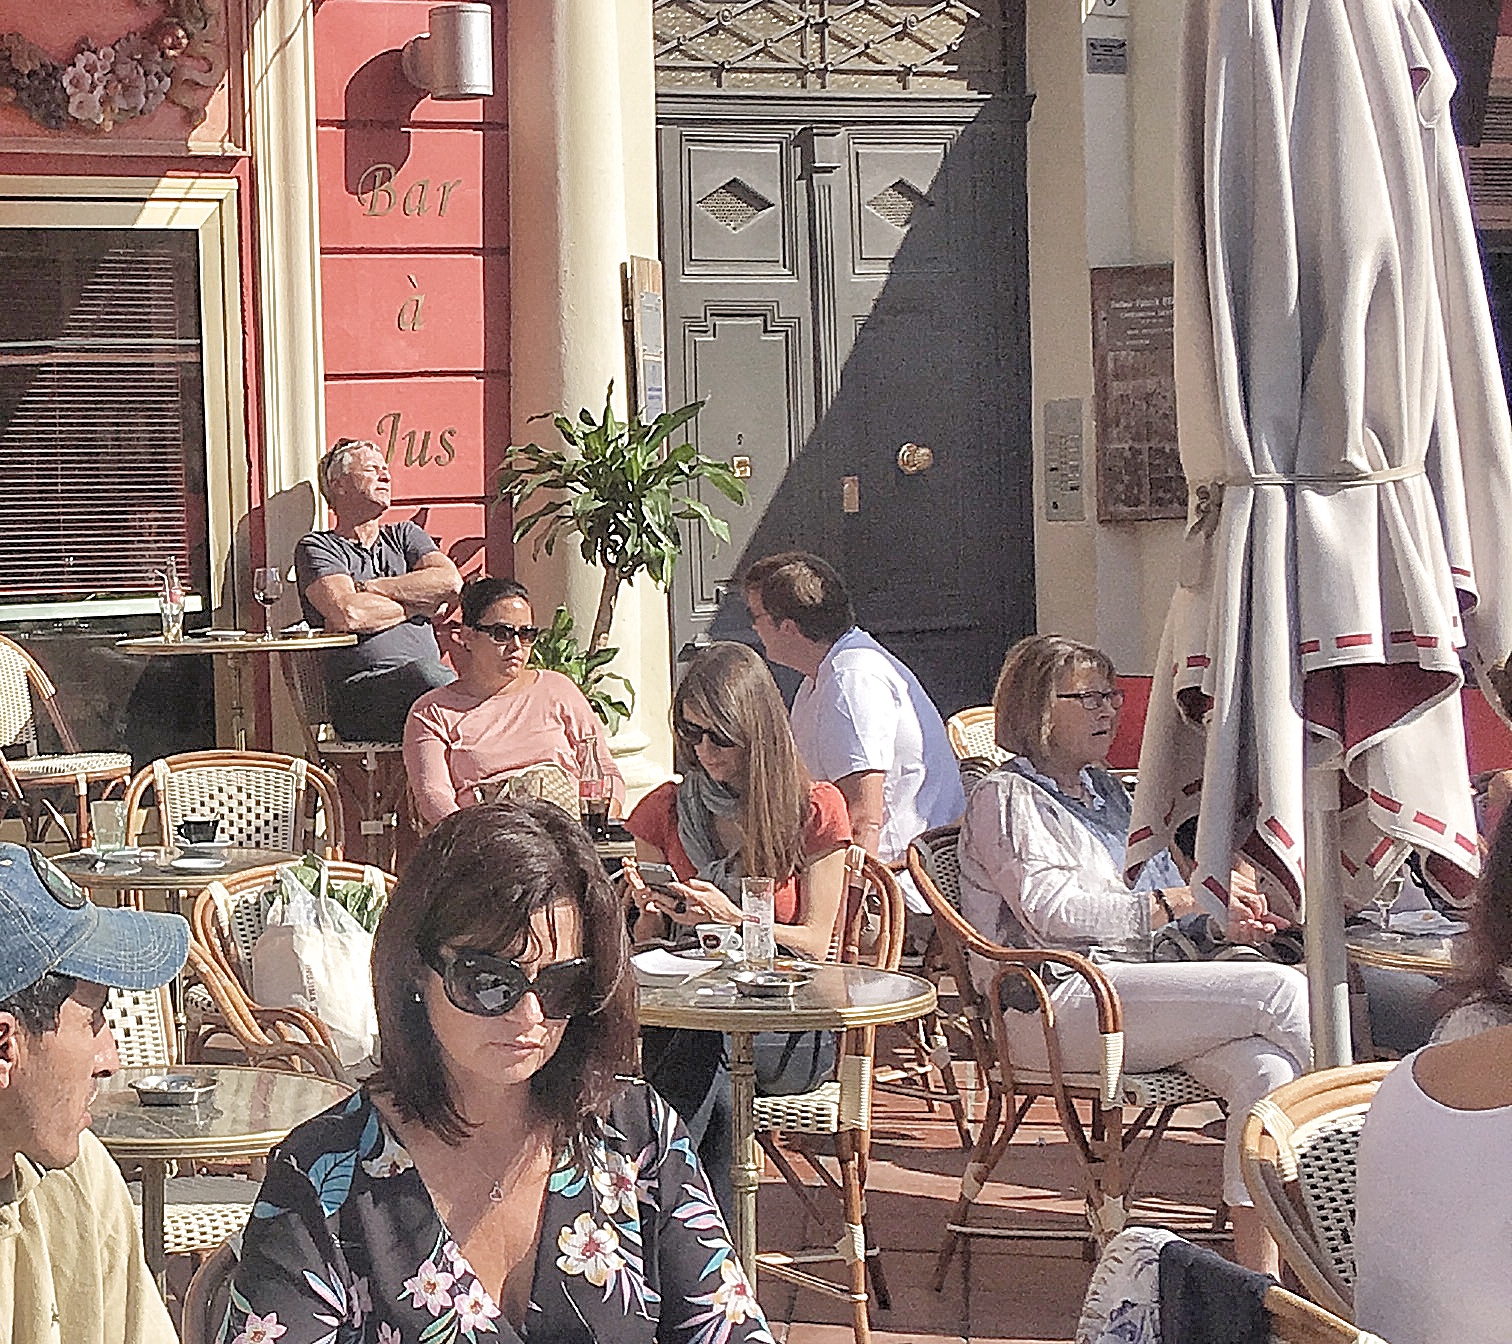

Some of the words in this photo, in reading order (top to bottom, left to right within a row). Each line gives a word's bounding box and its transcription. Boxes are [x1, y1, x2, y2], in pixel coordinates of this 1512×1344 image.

[357, 163, 462, 218] Bar
[397, 274, 427, 332] à
[376, 412, 457, 468] Jus
